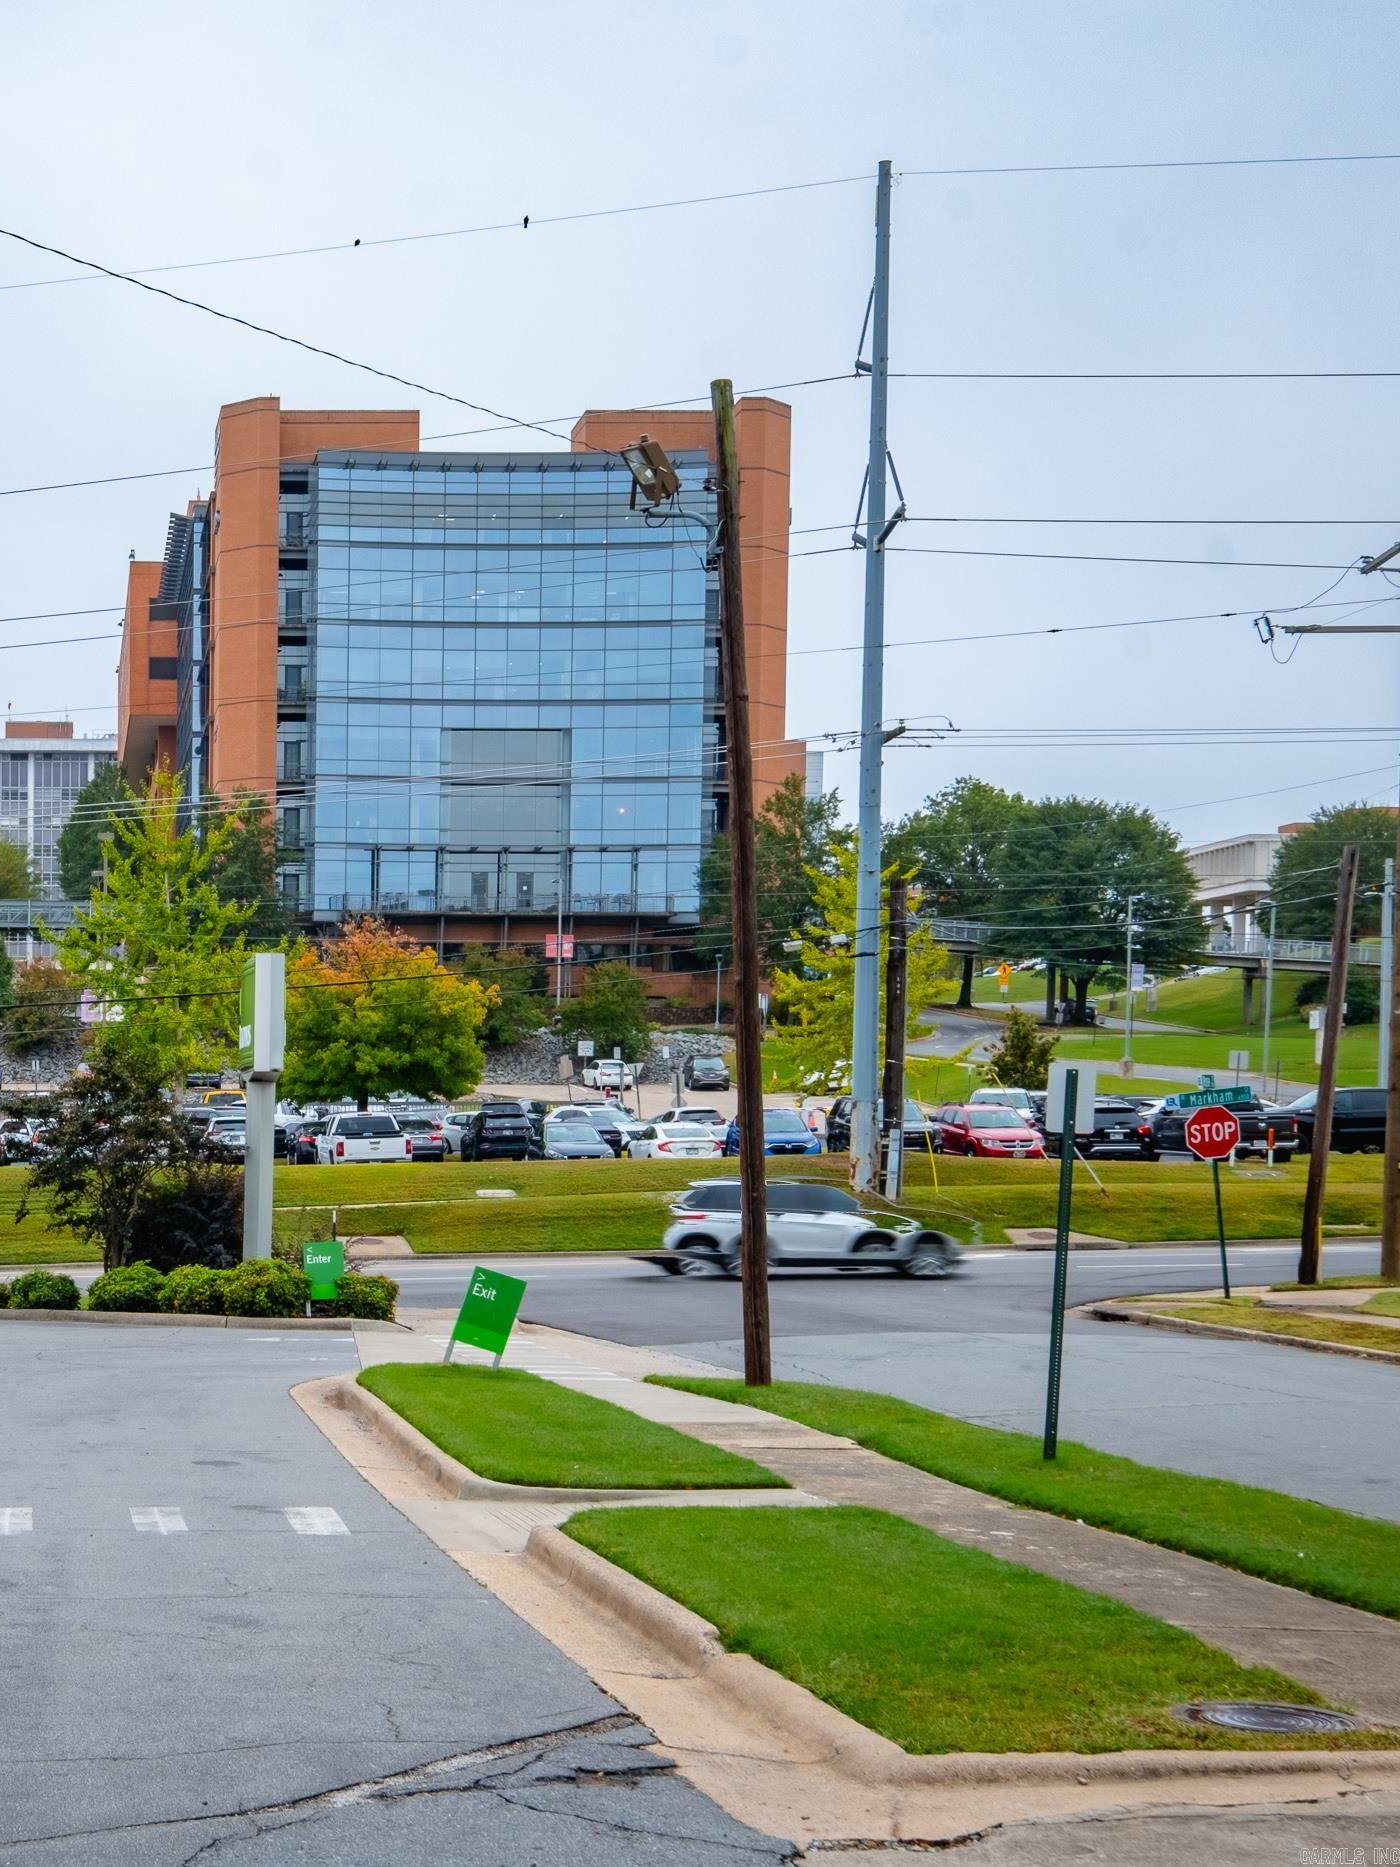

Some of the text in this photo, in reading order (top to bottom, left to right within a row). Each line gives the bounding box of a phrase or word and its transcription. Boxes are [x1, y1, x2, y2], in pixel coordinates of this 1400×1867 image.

[1189, 1091, 1233, 1106] Markham
[1190, 1121, 1236, 1144] STOP
[306, 1254, 331, 1264] Enter
[472, 1283, 497, 1301] Exit
